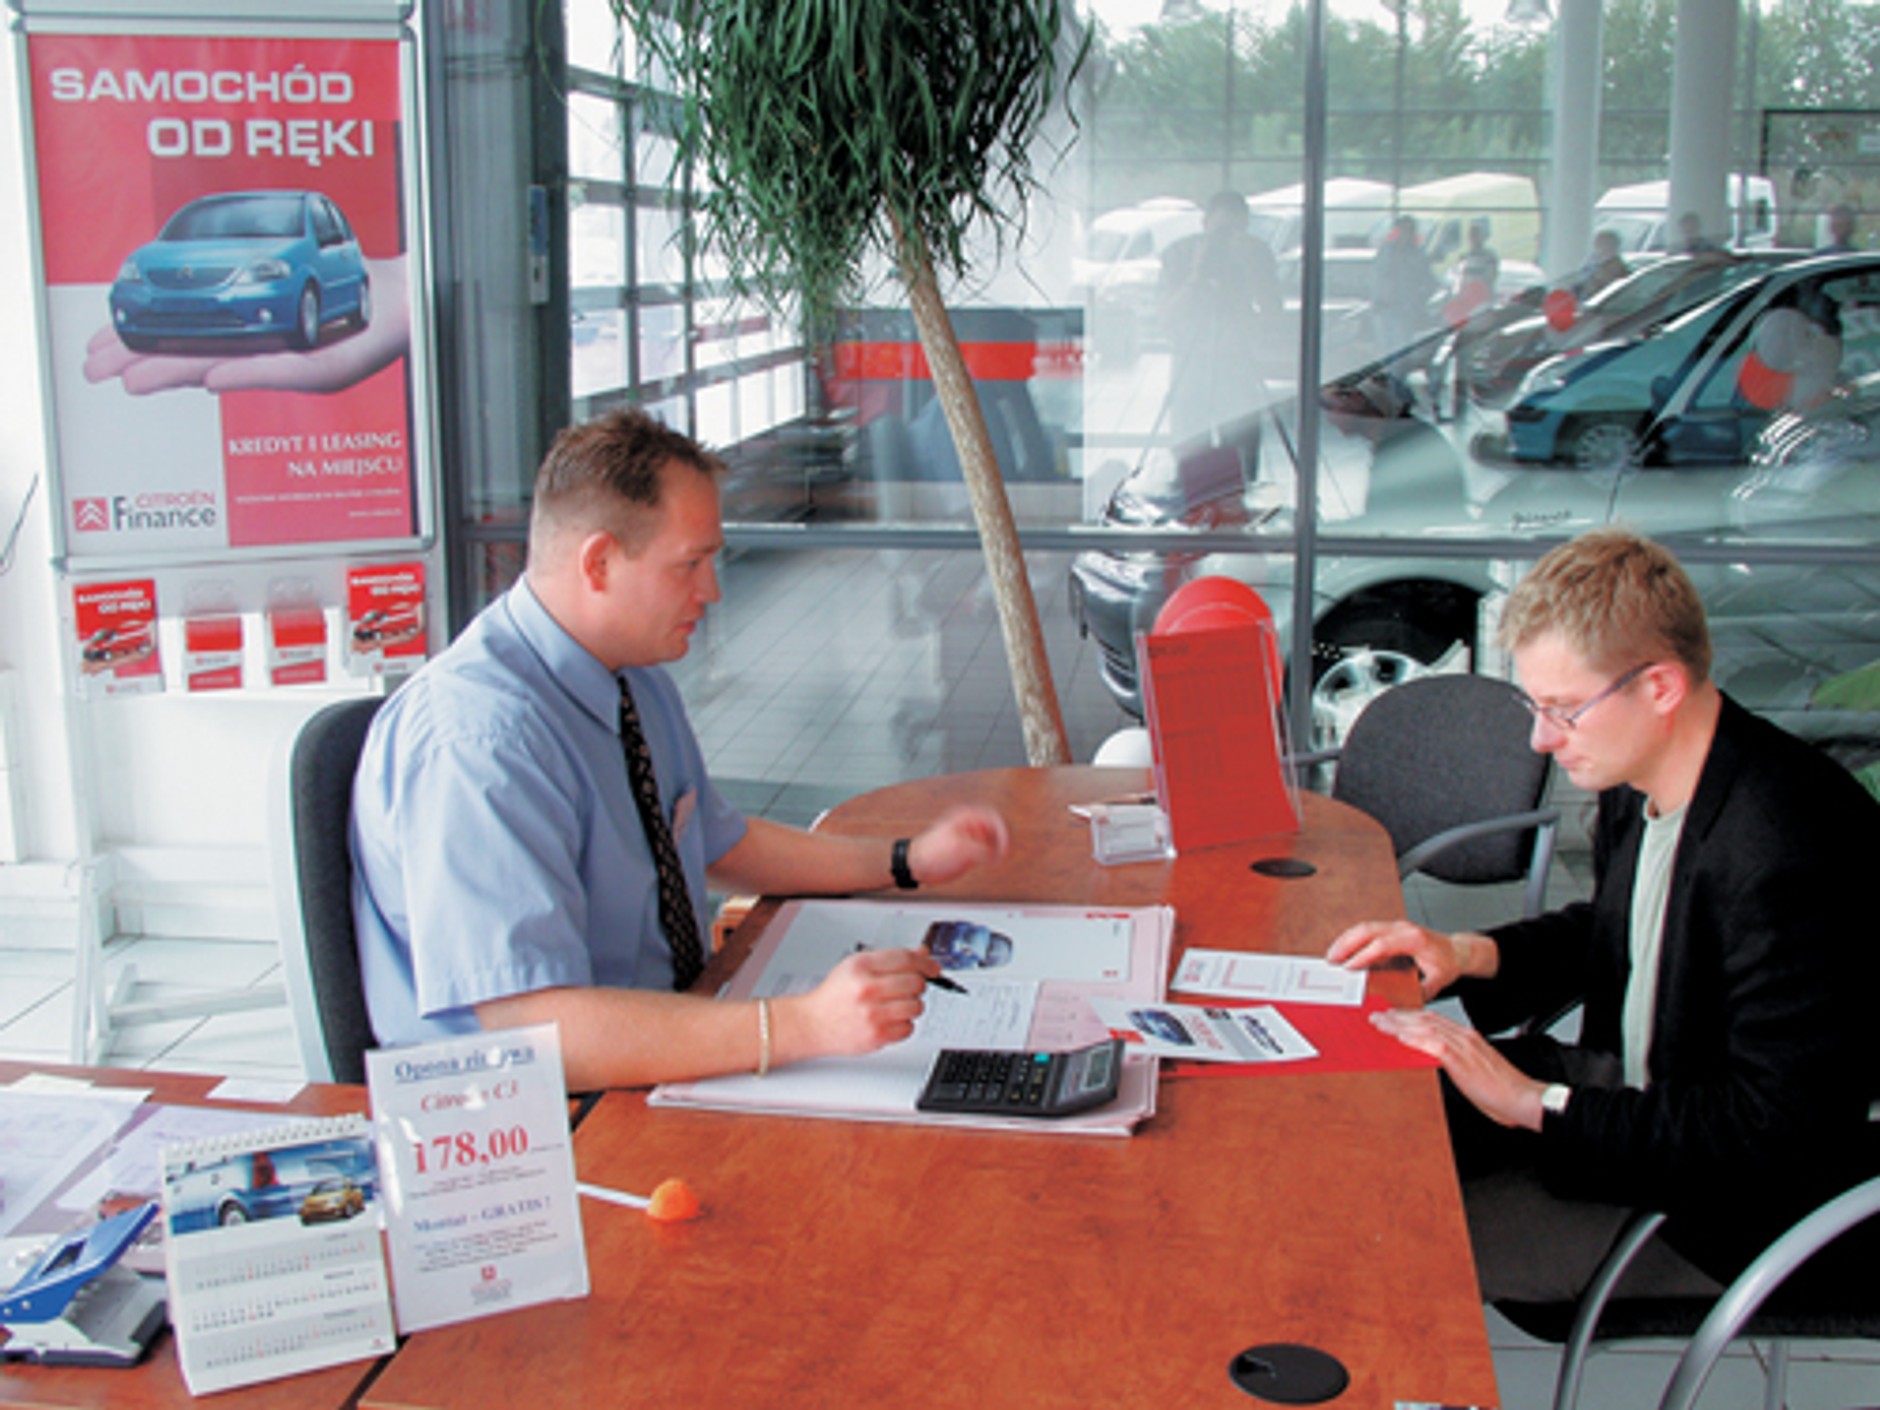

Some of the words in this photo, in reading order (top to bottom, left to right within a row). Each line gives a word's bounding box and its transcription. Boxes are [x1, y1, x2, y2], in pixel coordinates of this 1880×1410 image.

[50, 64, 353, 103] SAMOCHÓD
[147, 118, 232, 156] OD
[246, 119, 374, 166] RĘKI
[228, 435, 304, 455] KREDYT
[322, 431, 402, 453] LEASING
[288, 460, 317, 477] NA
[322, 456, 402, 476] MIEJSCU
[113, 496, 216, 531] Finance
[413, 1125, 528, 1174] 178,00
